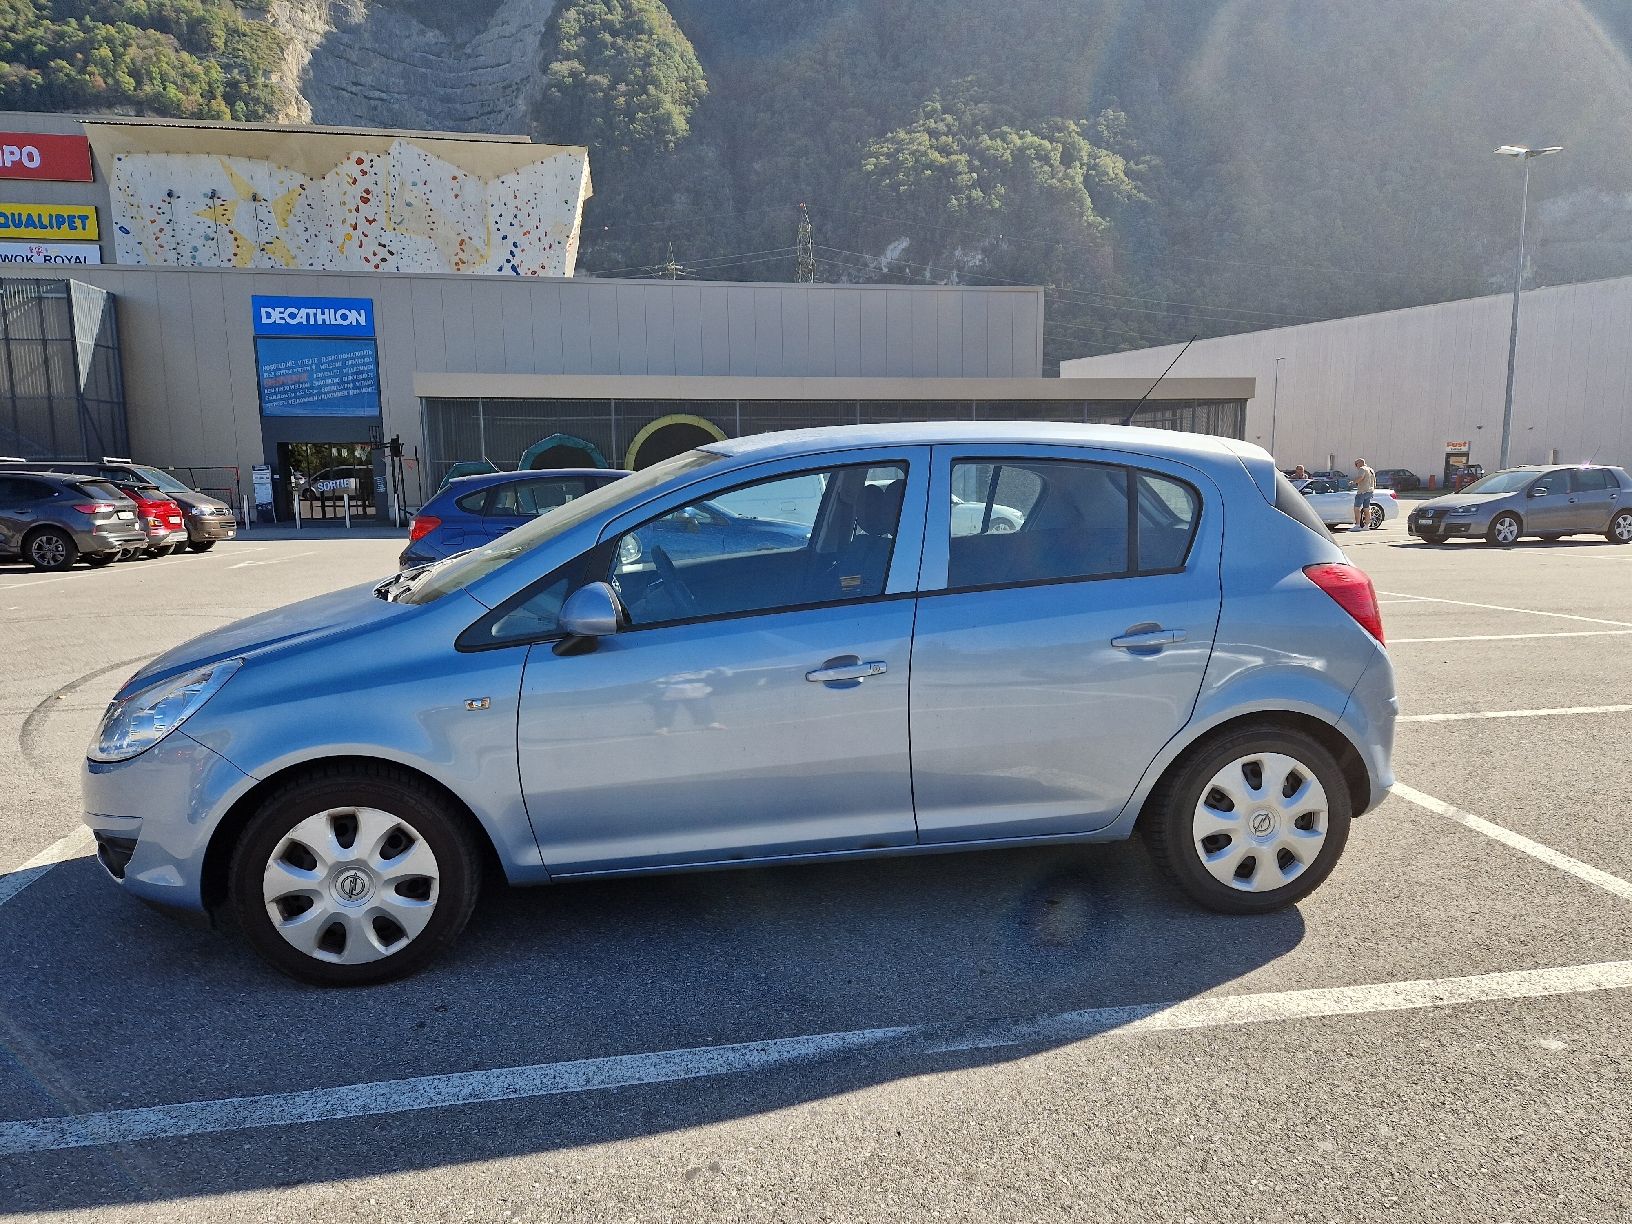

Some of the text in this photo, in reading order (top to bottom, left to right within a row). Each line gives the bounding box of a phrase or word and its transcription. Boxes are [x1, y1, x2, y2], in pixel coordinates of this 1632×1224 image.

[0, 211, 90, 231] QUALIPET
[0, 254, 35, 264] WOK
[260, 307, 367, 326] DECATHLON
[317, 478, 350, 492] SORTIE
